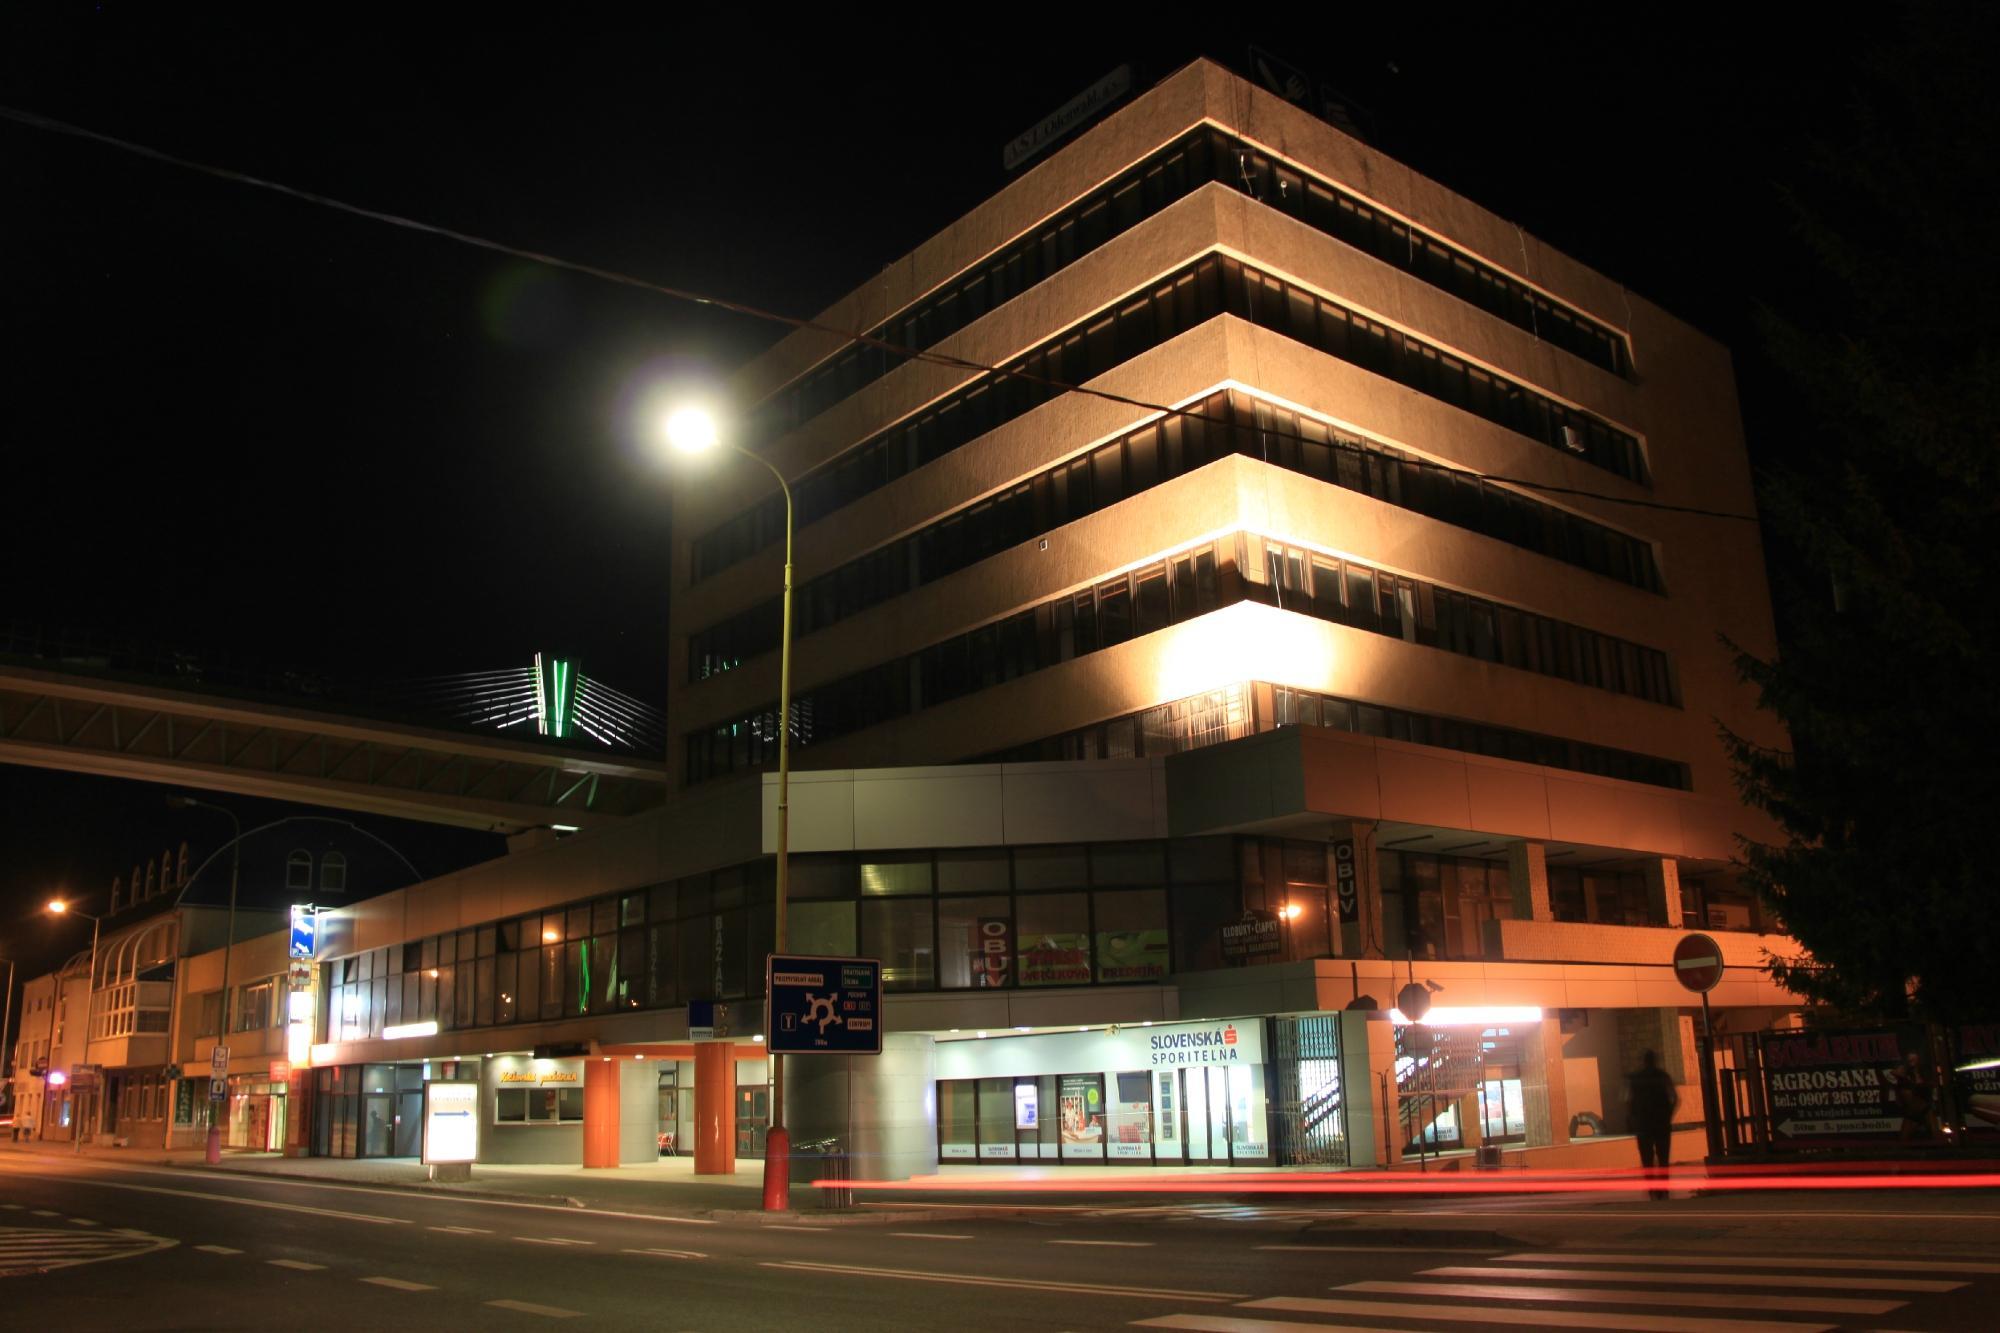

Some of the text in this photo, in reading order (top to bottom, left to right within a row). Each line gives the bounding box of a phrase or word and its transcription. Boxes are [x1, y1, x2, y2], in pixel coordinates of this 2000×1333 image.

[1336, 845, 1355, 913] OBUV
[983, 921, 1007, 987] OBUV
[1151, 1028, 1223, 1050] SLOVENSKÁ
[1772, 1068, 1880, 1091] AGROSANA
[1799, 1092, 1829, 1106] 0907
[1832, 1091, 1854, 1105] 261
[1857, 1090, 1880, 1104] 227
